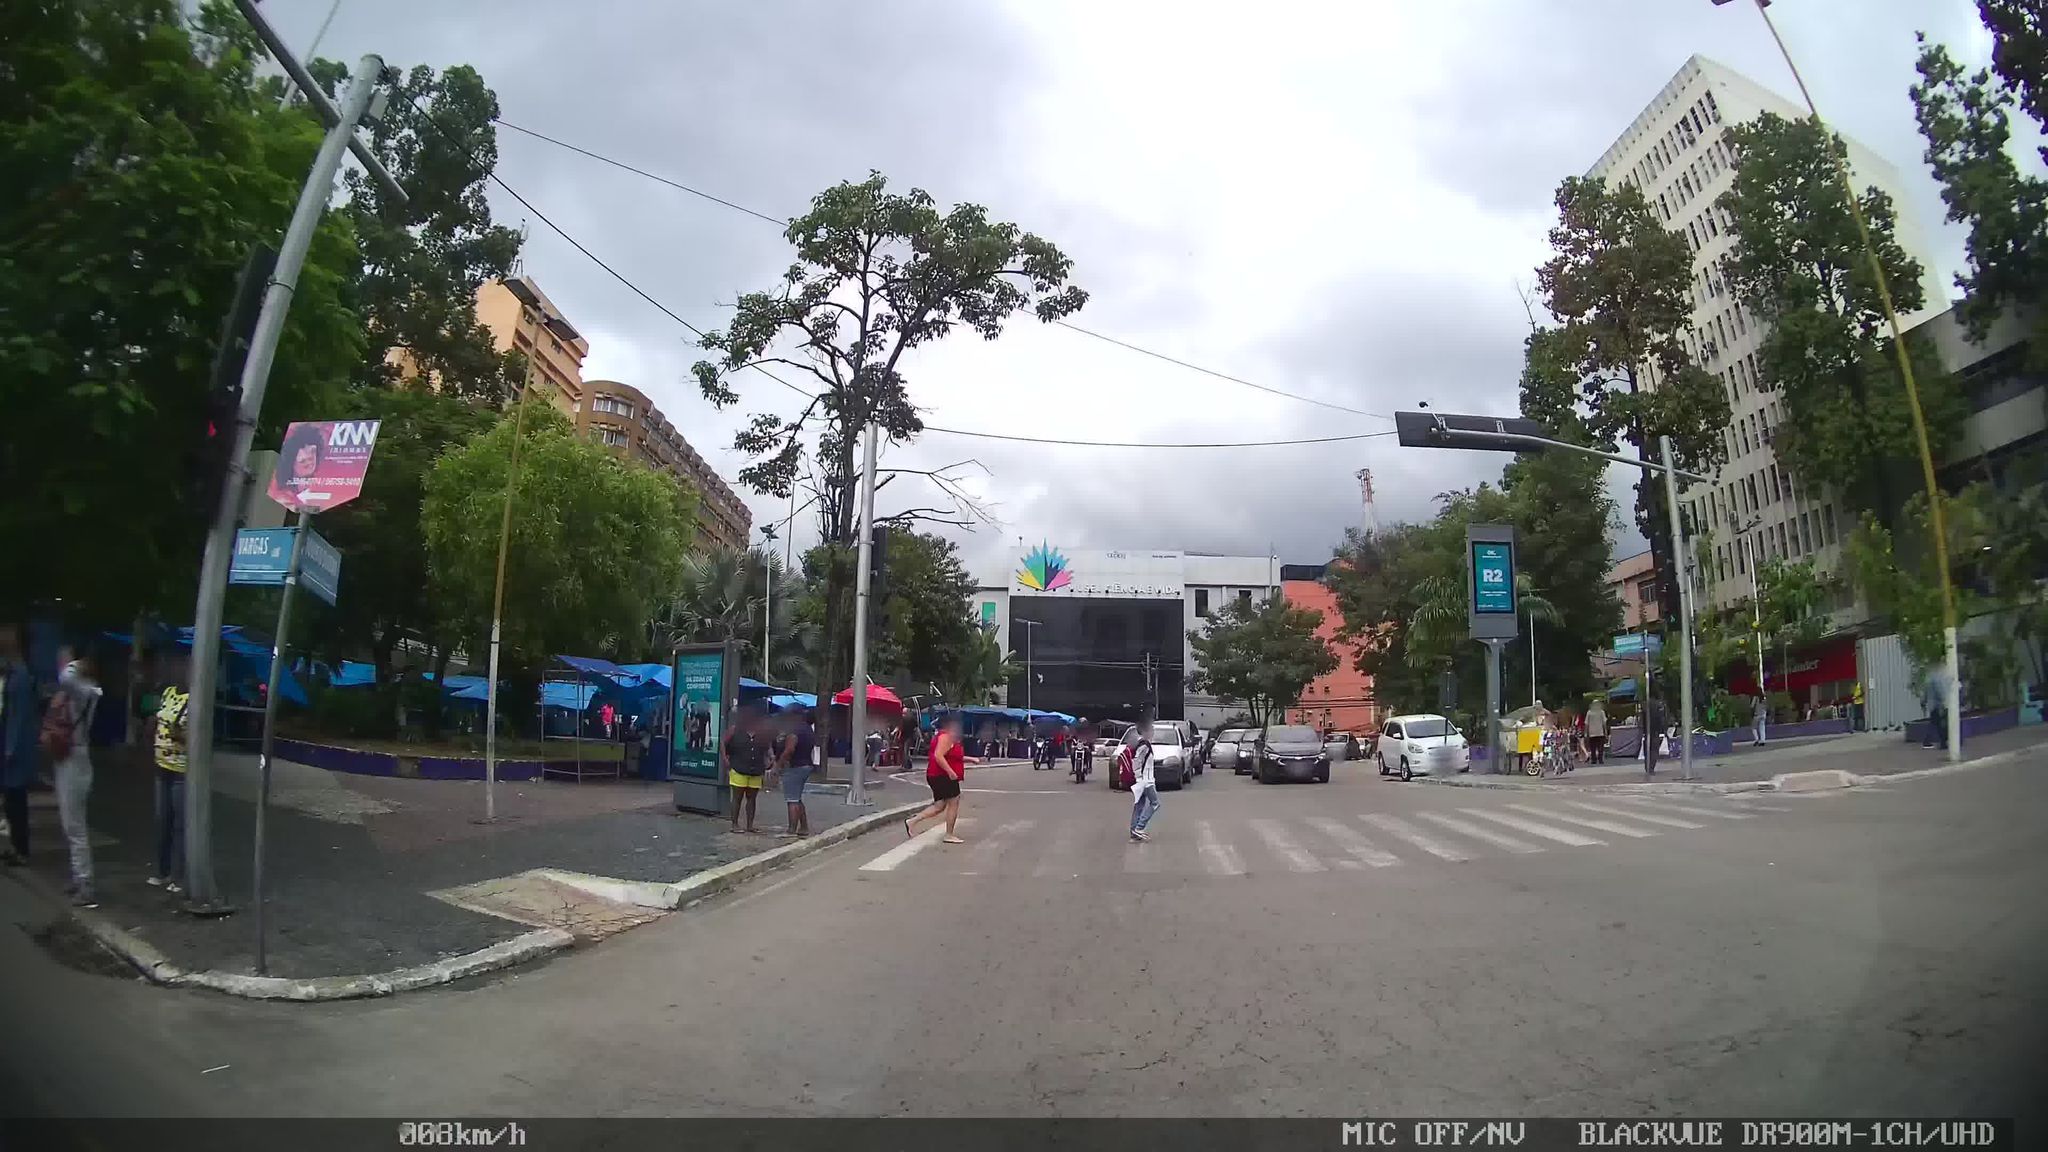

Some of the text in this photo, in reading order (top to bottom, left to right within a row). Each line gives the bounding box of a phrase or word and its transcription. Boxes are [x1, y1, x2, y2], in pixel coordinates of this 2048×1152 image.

[328, 421, 379, 446] KNN
[238, 536, 270, 556] VARGAS
[1482, 568, 1504, 583] R2
